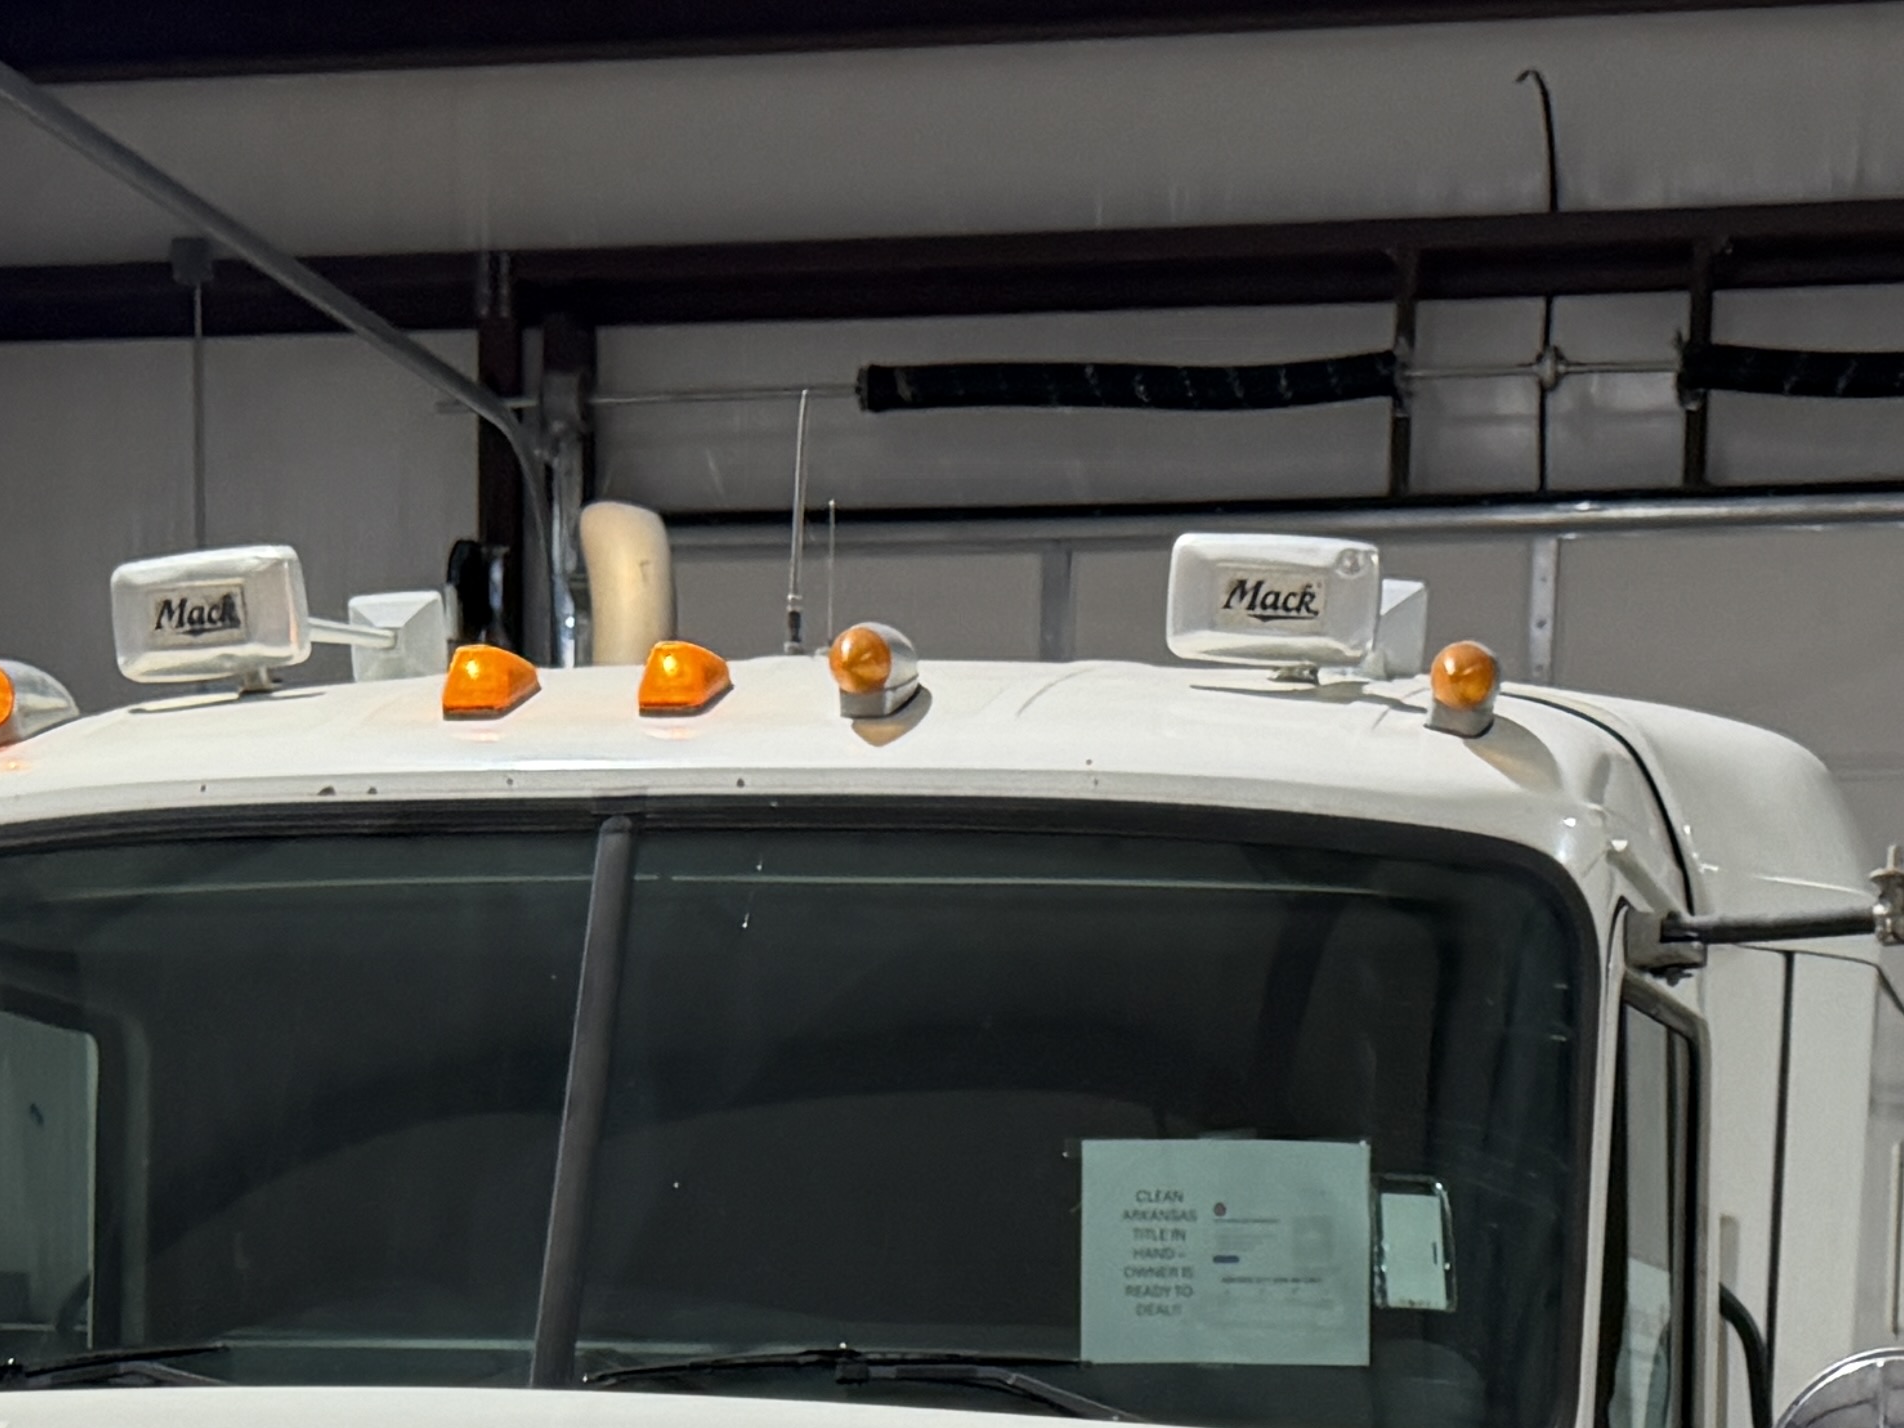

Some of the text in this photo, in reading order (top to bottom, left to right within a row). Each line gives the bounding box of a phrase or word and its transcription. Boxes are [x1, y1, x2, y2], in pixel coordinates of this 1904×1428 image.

[1222, 578, 1319, 615] Mack
[154, 593, 241, 631] Mack
[1135, 1189, 1184, 1203] CLEAN
[1122, 1208, 1198, 1222] ARKANSAS
[1132, 1227, 1186, 1241] TITLE IN
[1132, 1247, 1175, 1260] HAND
[1123, 1266, 1194, 1279] OWNER IS
[1124, 1284, 1194, 1298] READY TO
